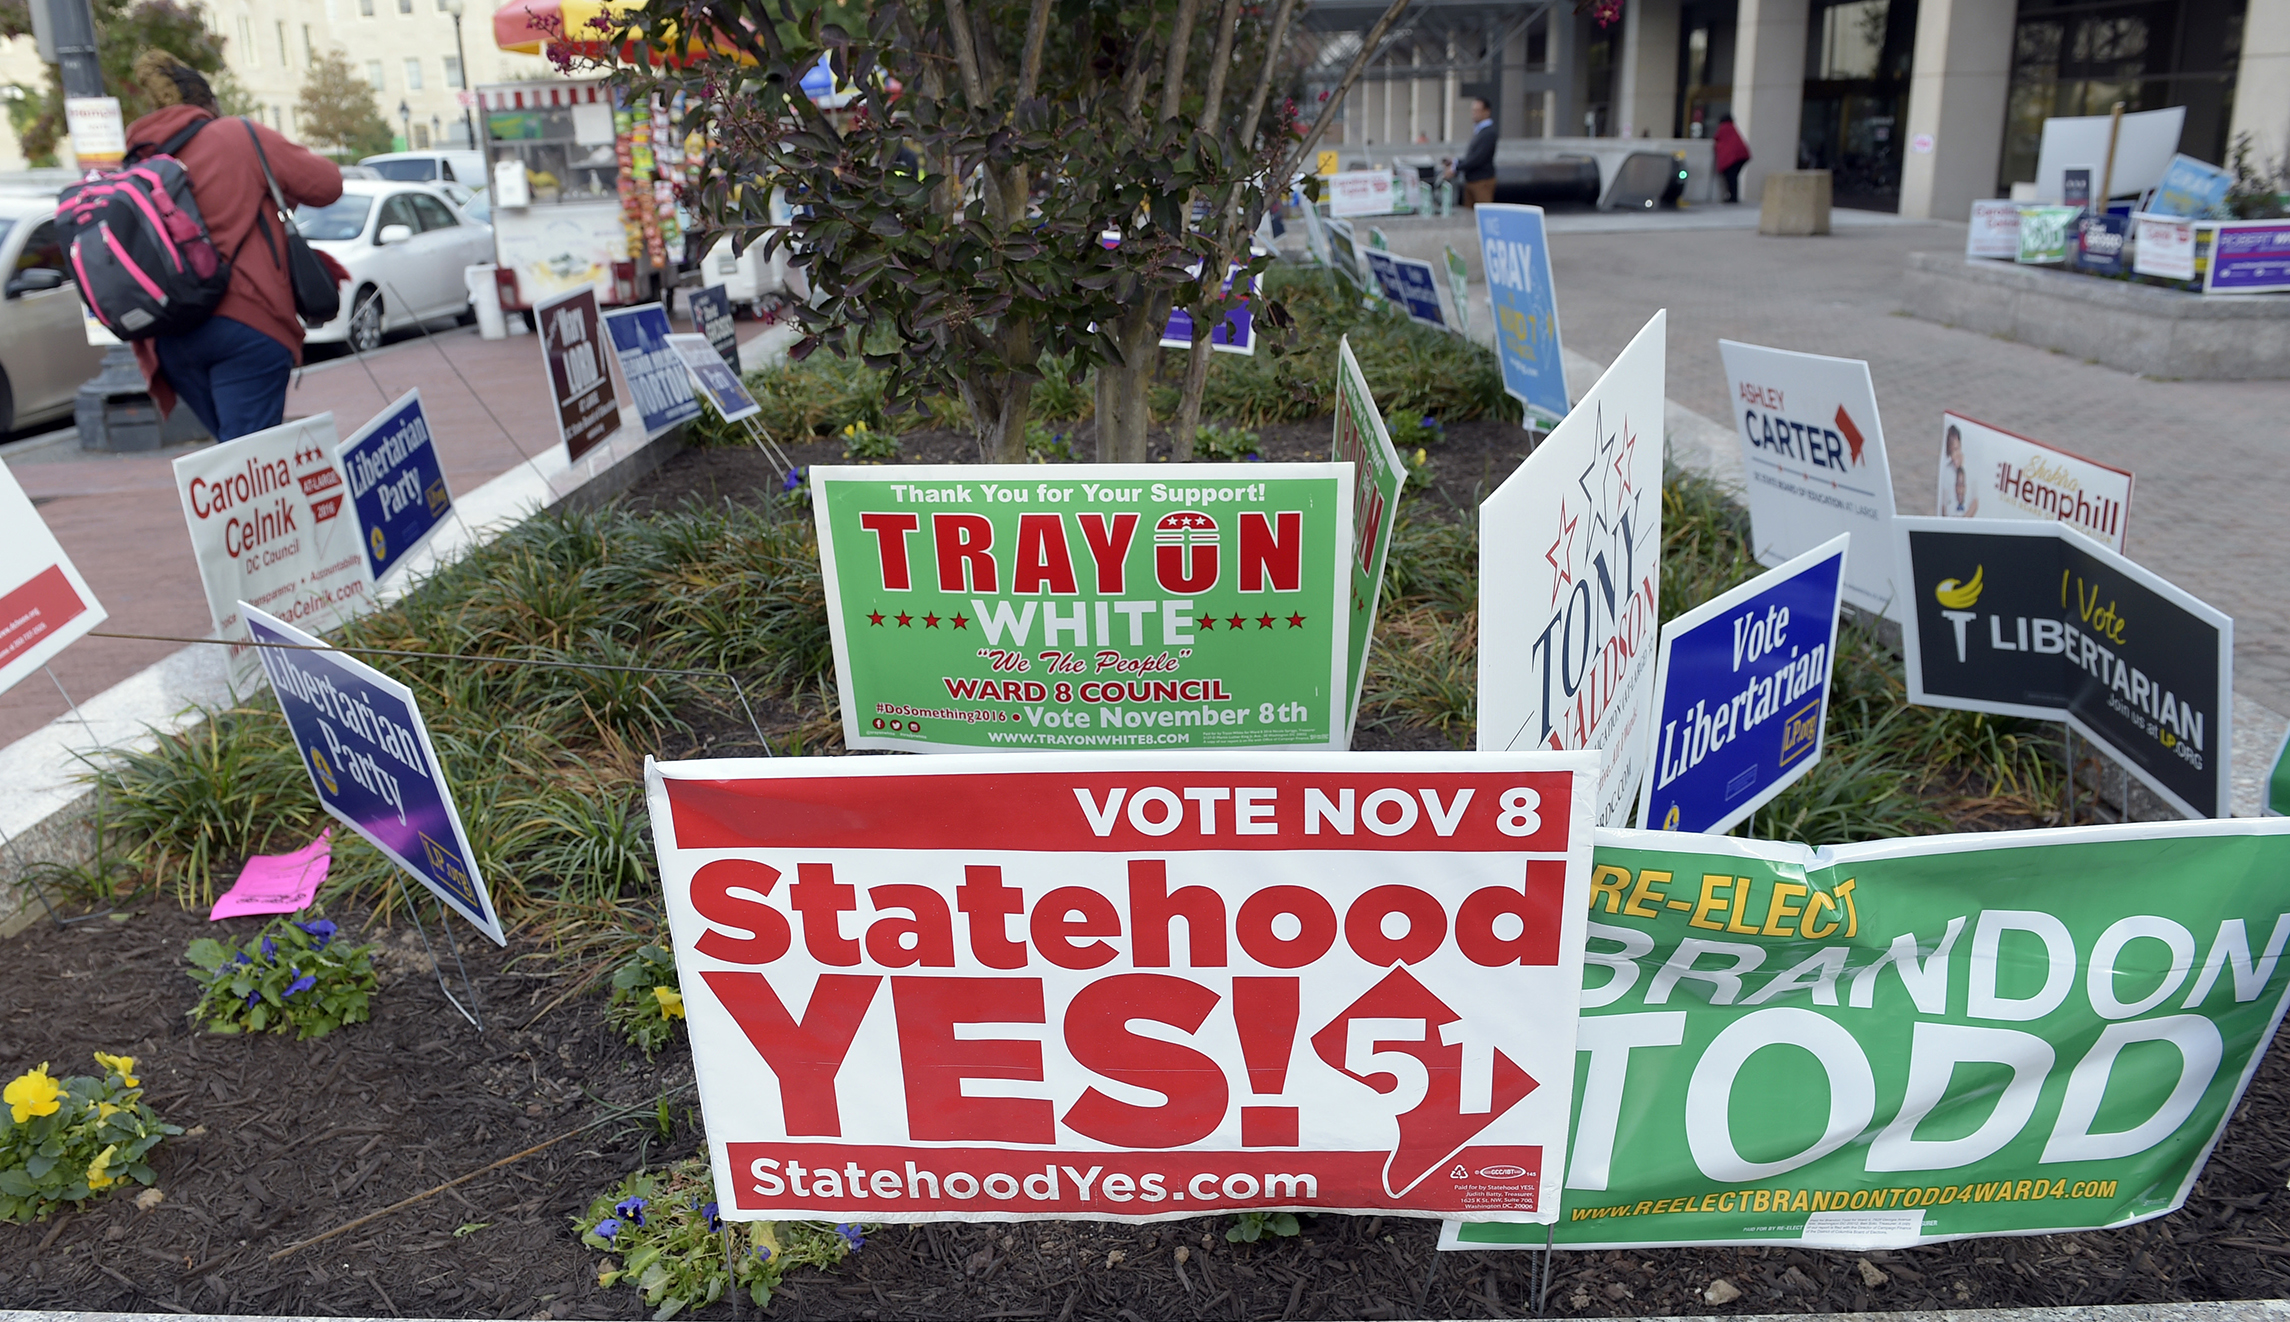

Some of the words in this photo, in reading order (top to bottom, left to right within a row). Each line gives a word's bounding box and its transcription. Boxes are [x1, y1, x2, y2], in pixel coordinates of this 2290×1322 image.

[1485, 237, 1532, 294] GRAY
[1740, 382, 1785, 411] ASHLEY
[346, 415, 429, 500] Libertarian
[1745, 409, 1848, 473] CARTER
[189, 458, 291, 520] Carolina
[377, 466, 424, 523] Party
[890, 483, 975, 503] Thank
[980, 484, 1030, 503] You
[1036, 483, 1074, 502] for
[1081, 484, 1145, 502] Your
[1150, 483, 1266, 508] Support!
[1999, 463, 2119, 536] Hemphill
[2023, 455, 2079, 492] Shakira
[225, 497, 296, 558] Celnik
[316, 501, 335, 519] 2016
[246, 555, 260, 574] DC
[263, 540, 300, 567] Council
[310, 554, 362, 583] Accountability
[860, 510, 1303, 595] TRAYON
[971, 599, 1195, 647] WHITE
[1532, 488, 1642, 750] TONY
[1733, 604, 1790, 673] Vote
[2061, 568, 2070, 609] I
[2077, 576, 2127, 646] Vote
[943, 677, 1047, 703] WARD
[1053, 680, 1073, 703] 8
[1079, 678, 1231, 703] COUNCIL
[1040, 650, 1087, 675] The
[1989, 614, 2204, 752] LIBERTARIAN
[257, 635, 429, 779] Libertarian
[876, 702, 1007, 724] #DoSomething2016
[1024, 705, 1091, 730] Vote
[1100, 702, 1250, 729] November
[1258, 701, 1309, 724] 8th
[1657, 642, 1826, 791] Libertarian
[1784, 715, 1817, 752] LP.org
[2106, 693, 2130, 719] Join
[2131, 711, 2146, 730] us
[2146, 722, 2159, 739] at
[2159, 728, 2204, 770] LP.ORG
[987, 732, 1190, 746] WWW.TRAYONWHITE8.COM
[316, 717, 407, 828] Party
[1075, 787, 1280, 837] VOTE
[1304, 787, 1475, 837] NOV
[1496, 787, 1542, 836] 8
[689, 857, 1566, 970] Statehood
[1588, 863, 1857, 940] RE-ELECT
[1580, 908, 2290, 1022] BRANDON
[698, 970, 1301, 1149] YES!
[1344, 1015, 1495, 1116] 51
[1565, 1006, 2225, 1192] TODD
[751, 1157, 1318, 1203] StatehoodYes.com
